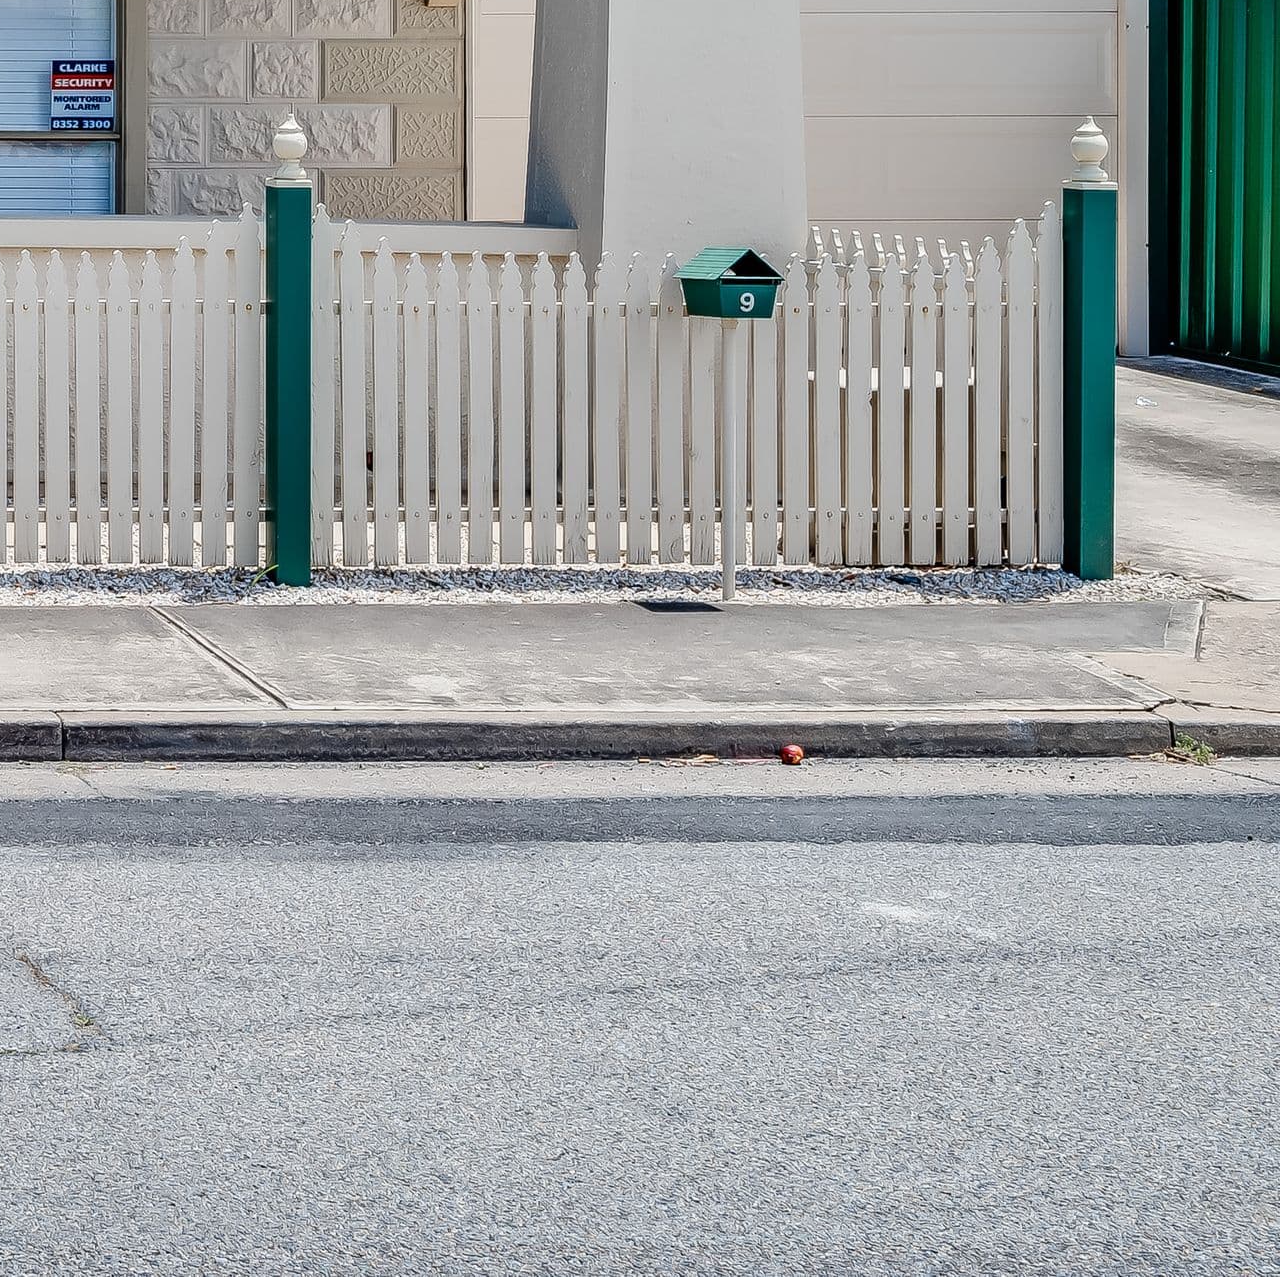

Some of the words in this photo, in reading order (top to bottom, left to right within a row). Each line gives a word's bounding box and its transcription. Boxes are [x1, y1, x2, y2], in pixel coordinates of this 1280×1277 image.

[59, 63, 108, 73] CLARKE
[54, 78, 113, 88] SECURITY
[53, 95, 112, 103] MONITORED
[63, 103, 101, 111] ALARM
[52, 120, 79, 129] 8352
[82, 120, 111, 129] 3300
[739, 292, 755, 312] 9
